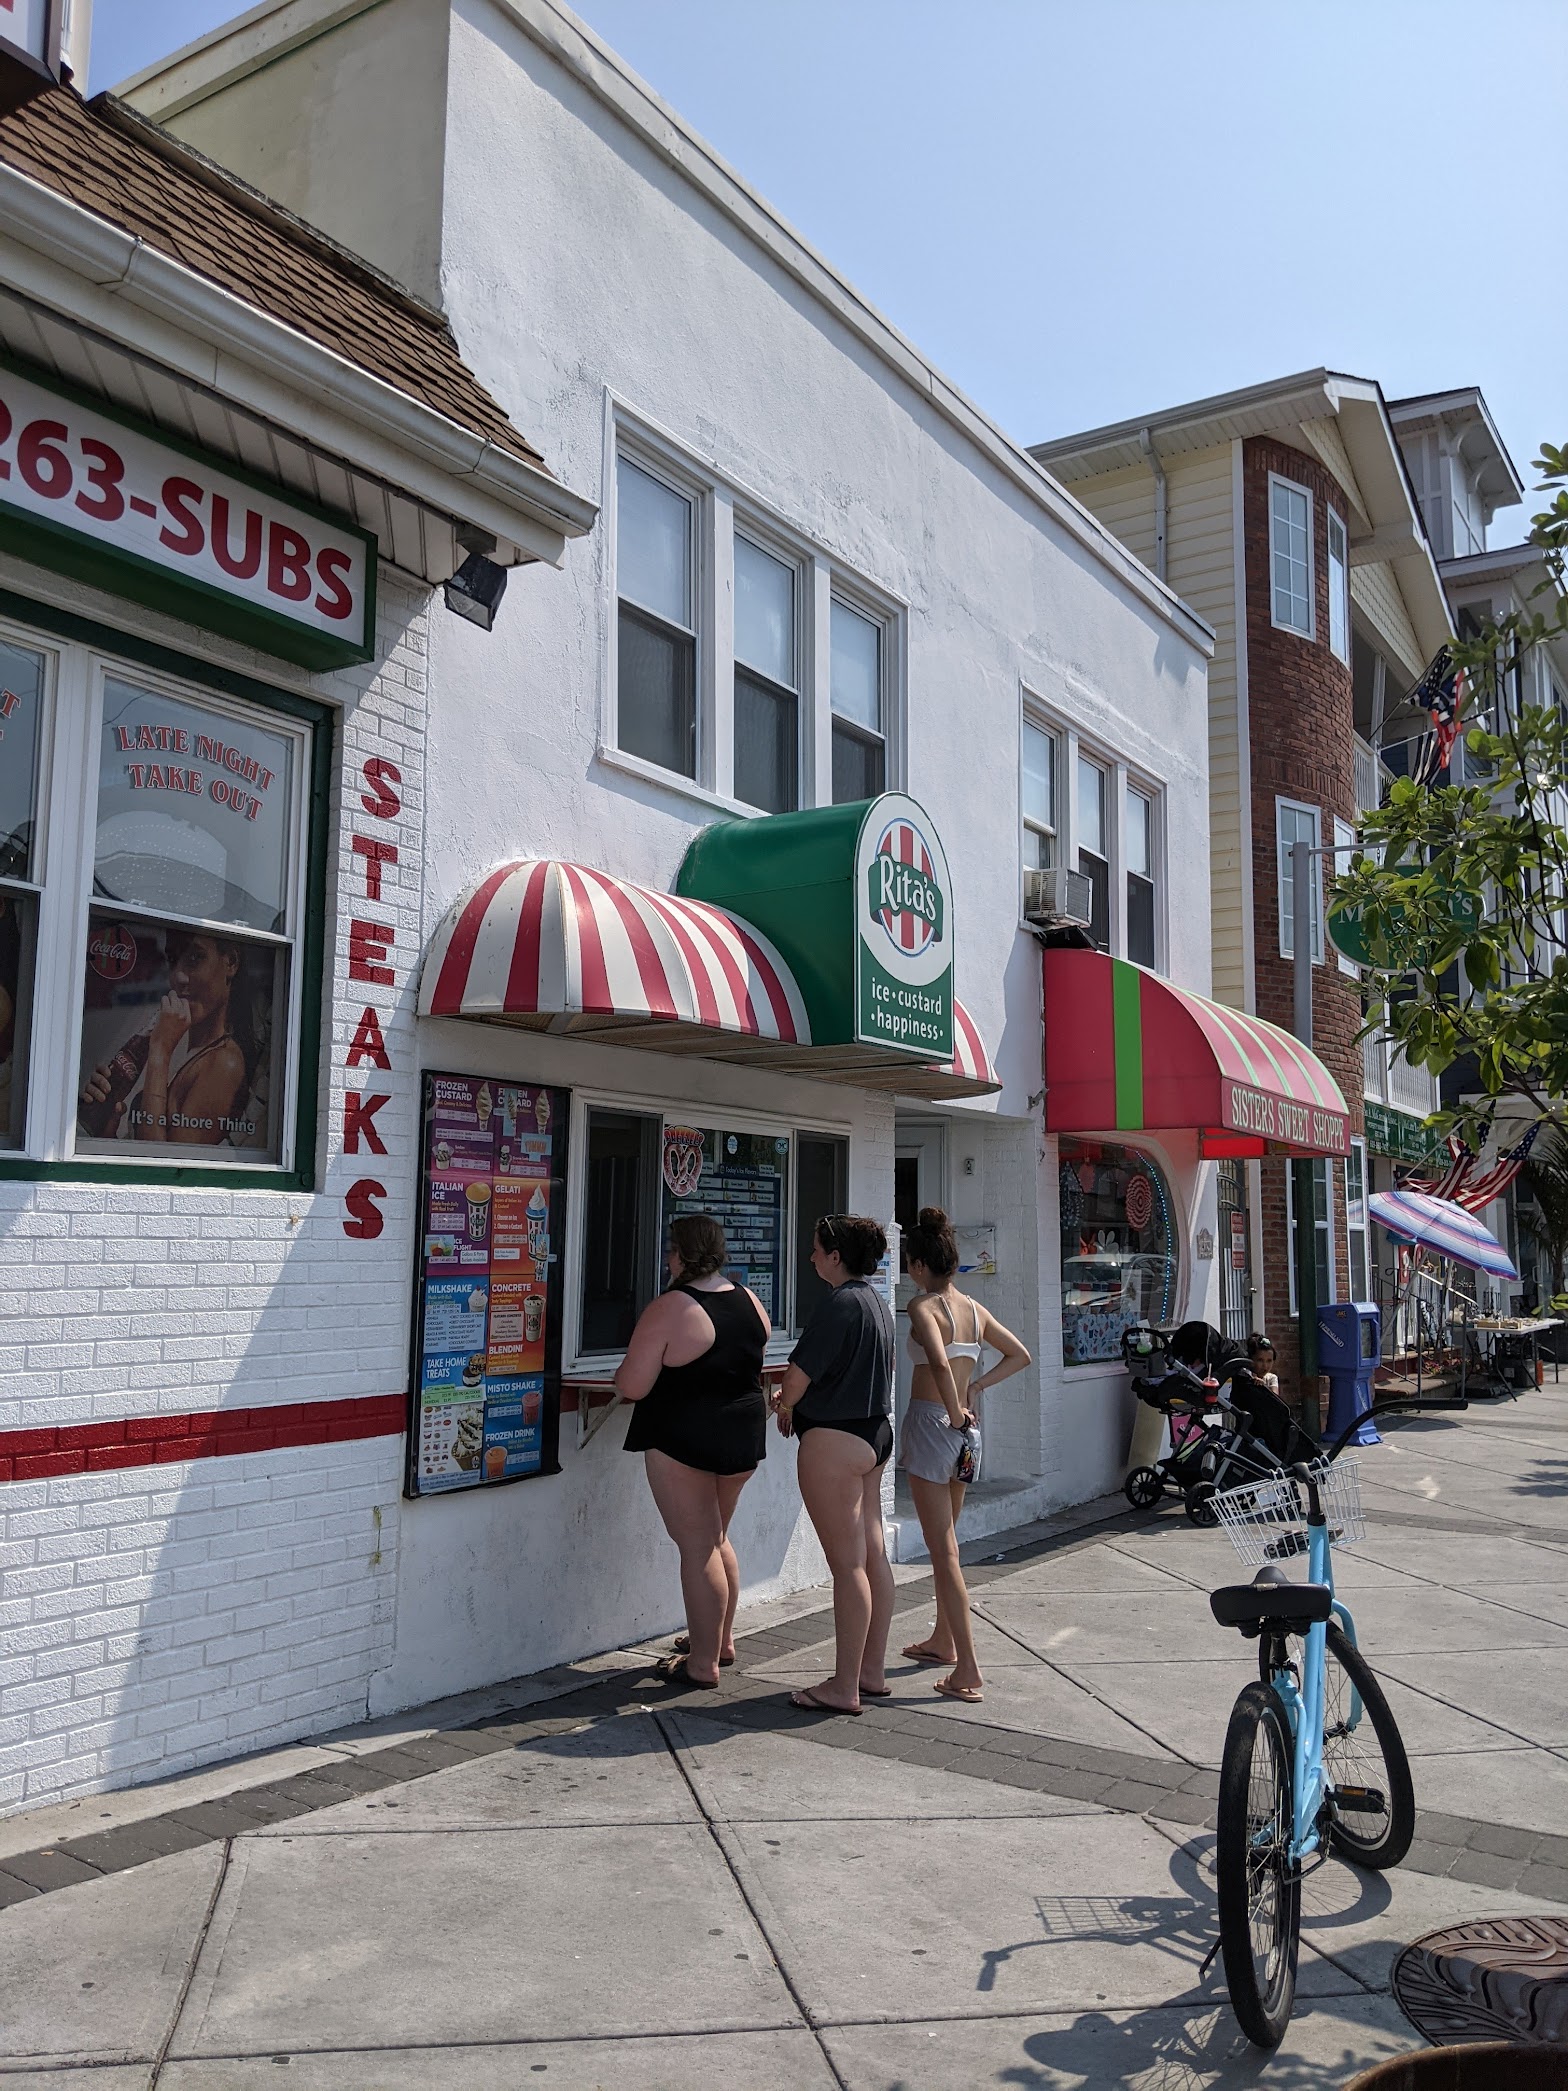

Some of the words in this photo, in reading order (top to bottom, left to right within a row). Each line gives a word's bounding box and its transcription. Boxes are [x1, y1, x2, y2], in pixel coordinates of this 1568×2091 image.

[0, 399, 353, 620] 63-SUBS
[117, 724, 190, 753] LATE
[197, 735, 277, 792] NIGHT
[128, 763, 204, 796] TAKE
[211, 779, 264, 822] OUT
[880, 855, 937, 922] Rita's
[342, 757, 402, 1240] STEAKS
[872, 977, 890, 1003] ice
[898, 990, 943, 1016] custard
[436, 1080, 468, 1092] FROZEN
[435, 1090, 473, 1102] CUSTARD
[131, 1110, 154, 1126] It's
[158, 1117, 168, 1128] a
[171, 1112, 214, 1132] Shore
[217, 1116, 258, 1140] Thing
[1231, 1086, 1275, 1135] SISTERS
[1277, 1101, 1310, 1144] SWEET
[1313, 1111, 1345, 1151] SHOPPE
[431, 1181, 464, 1192] ITALIAN
[494, 1185, 521, 1194] GELATI
[431, 1191, 446, 1200] ICE
[427, 1284, 472, 1294] MILKSHAKE
[491, 1283, 532, 1293] CONCRETE
[488, 1344, 523, 1355] BLENDINI
[426, 1358, 444, 1369] TAKE
[445, 1356, 467, 1367] HOME
[426, 1368, 450, 1380] TREATS
[487, 1383, 510, 1393] MISTO
[511, 1380, 536, 1391] SHAKE
[485, 1430, 514, 1442] FROZEN
[514, 1427, 535, 1438] DRINK
